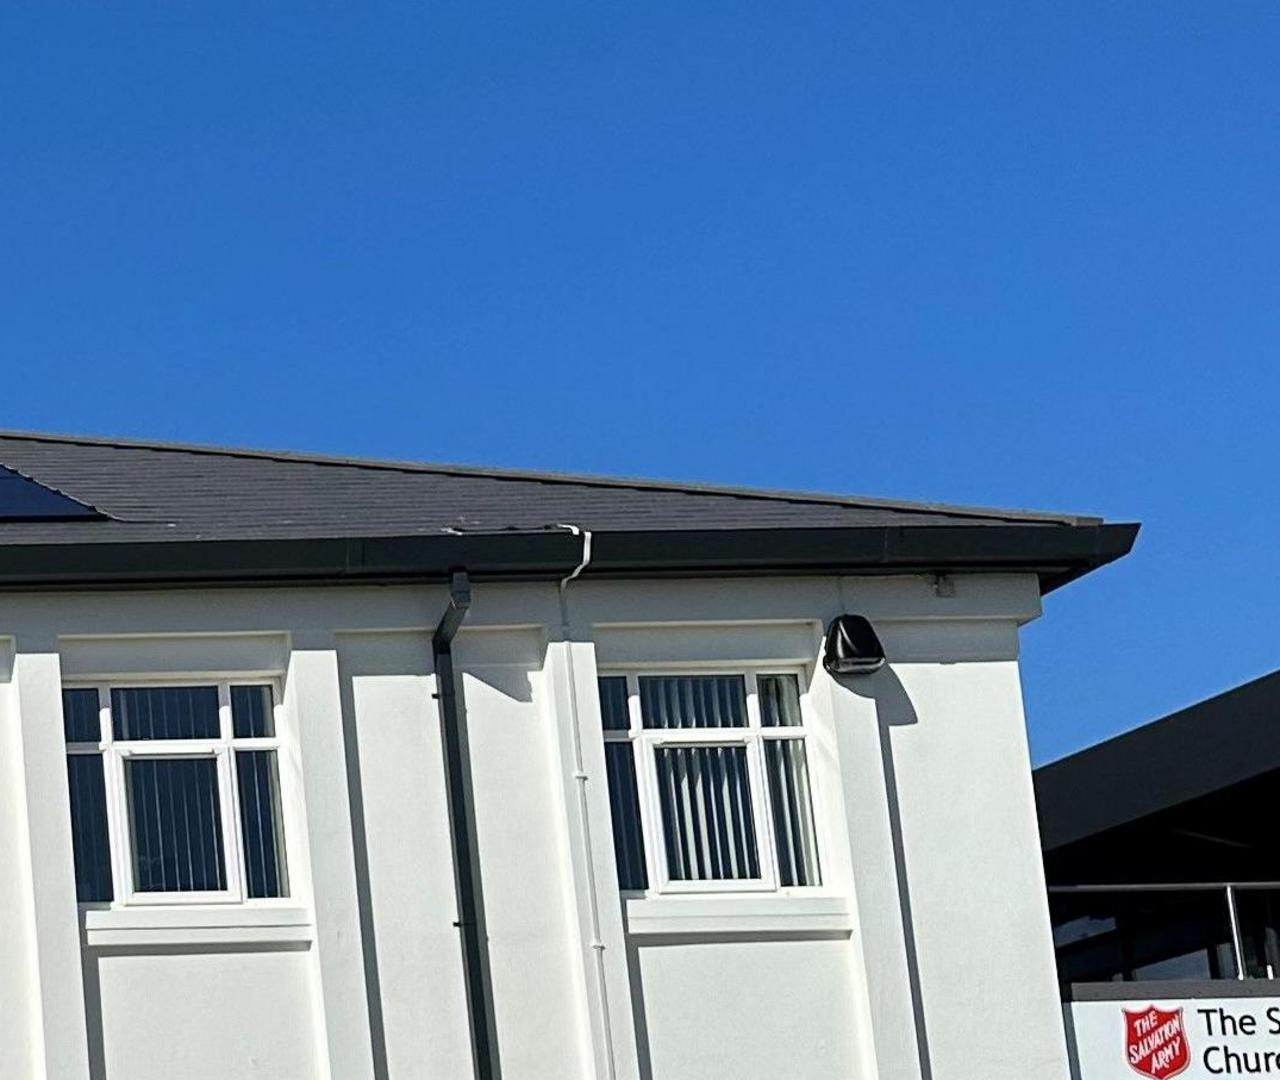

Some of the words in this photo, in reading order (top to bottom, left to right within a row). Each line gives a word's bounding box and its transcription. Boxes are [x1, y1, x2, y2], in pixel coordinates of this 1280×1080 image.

[1134, 1010, 1158, 1037] THE
[1197, 1008, 1256, 1036] The
[1129, 1014, 1180, 1064] SALVATION
[1151, 1036, 1180, 1074] ARMY
